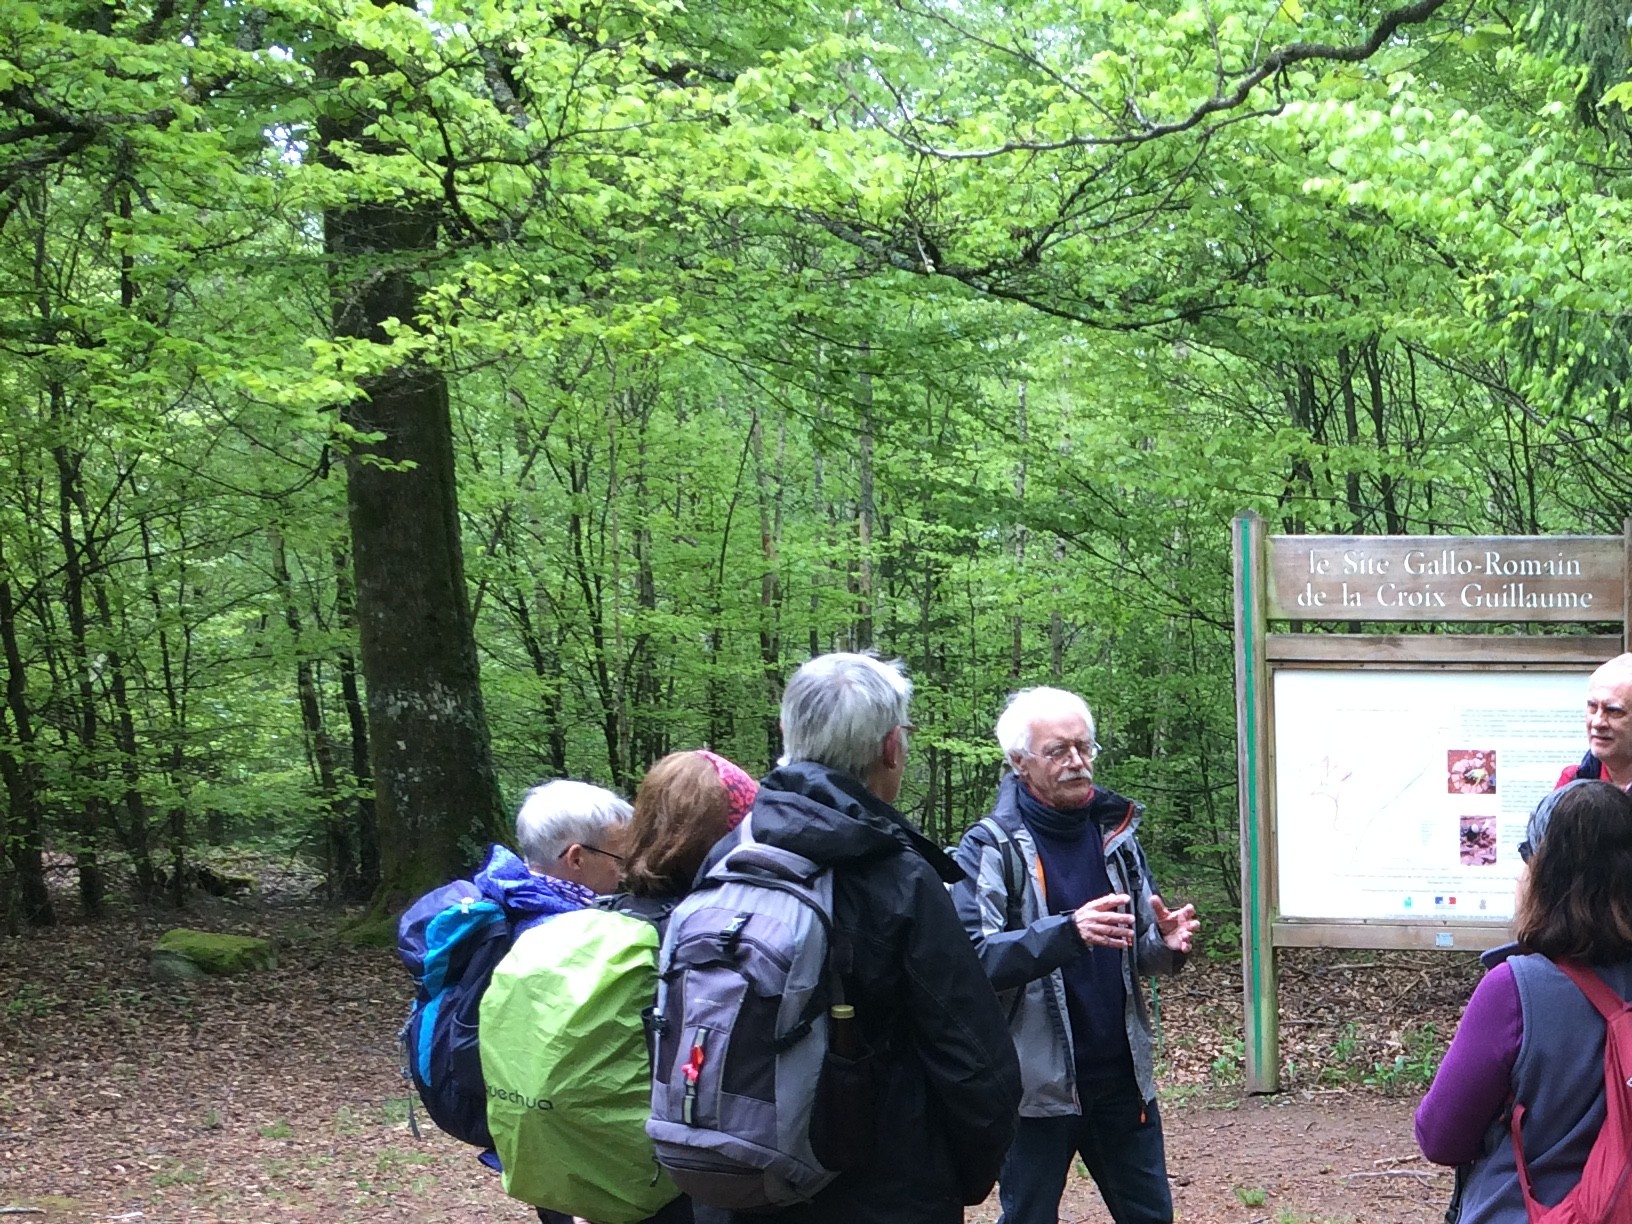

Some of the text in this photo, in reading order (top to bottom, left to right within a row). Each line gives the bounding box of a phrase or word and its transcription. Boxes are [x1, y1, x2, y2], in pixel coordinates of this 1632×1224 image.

[1308, 549, 1581, 576] le Site Gallo-Romain
[1296, 582, 1594, 608] de la Croix Guillaume
